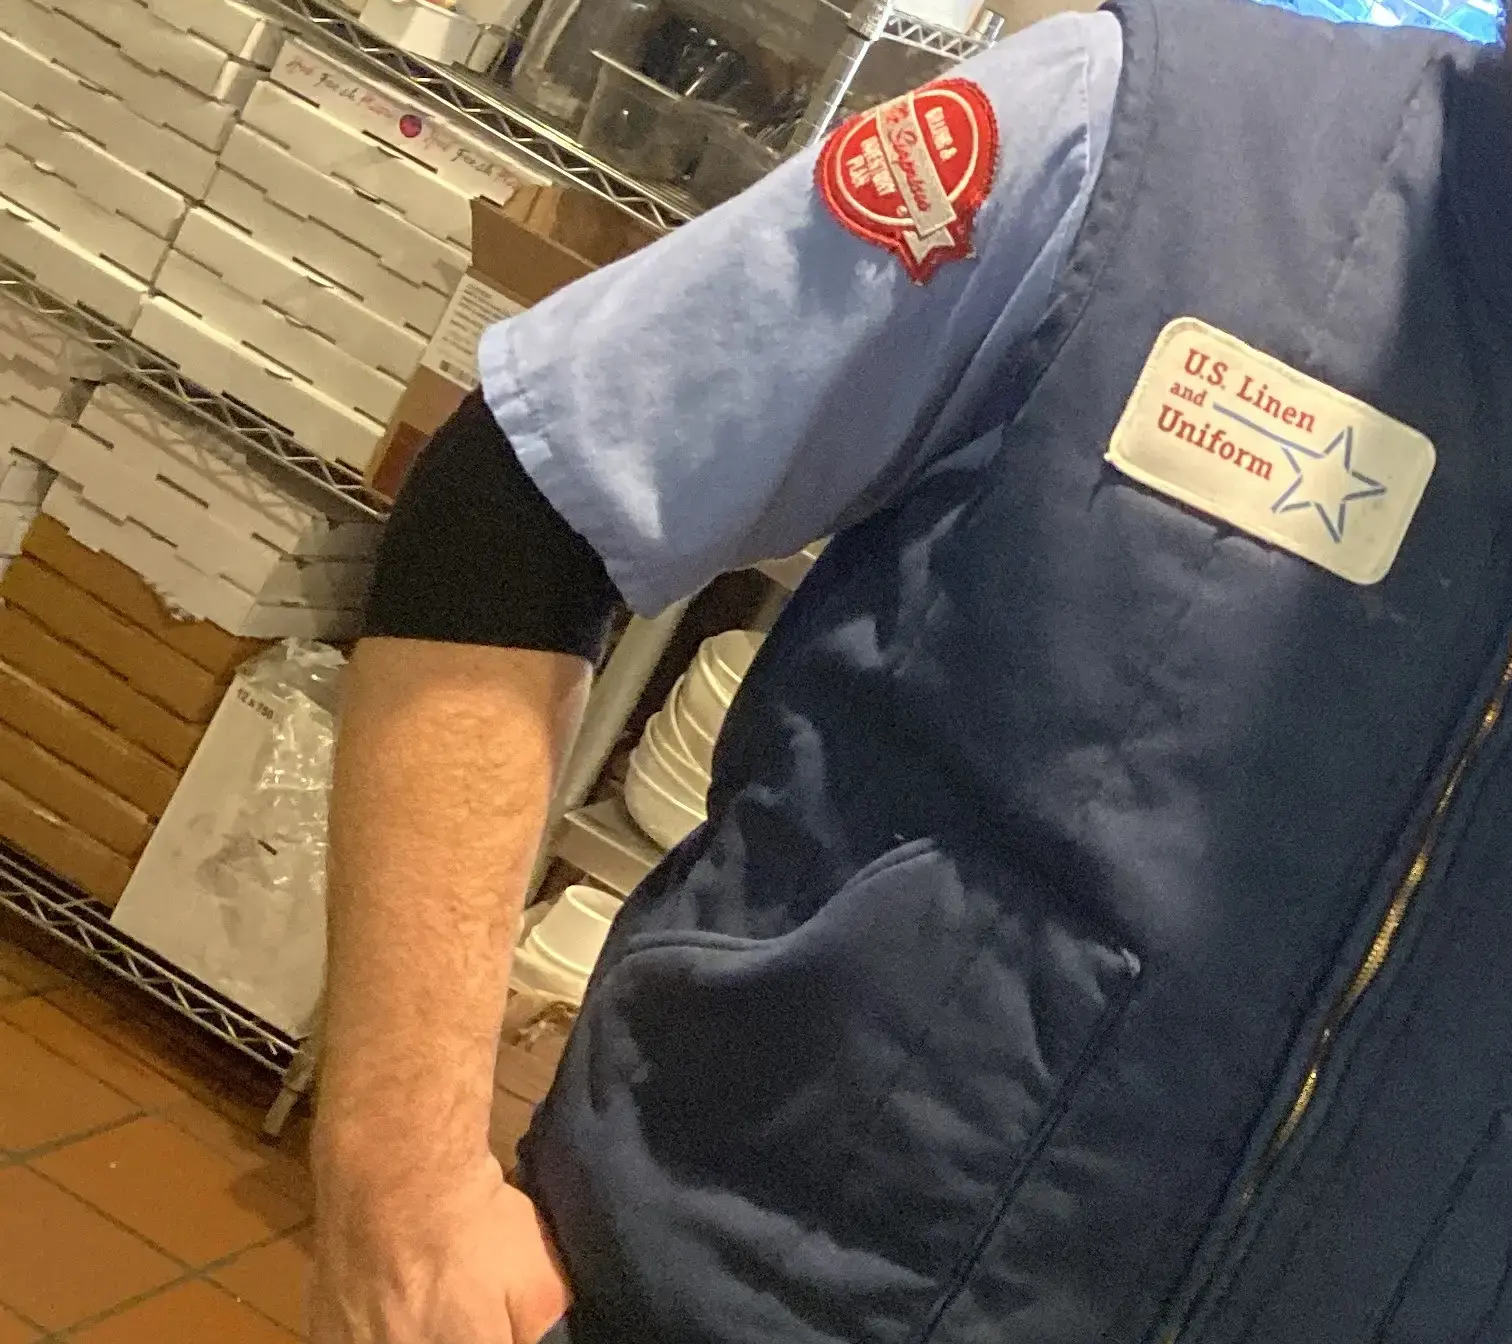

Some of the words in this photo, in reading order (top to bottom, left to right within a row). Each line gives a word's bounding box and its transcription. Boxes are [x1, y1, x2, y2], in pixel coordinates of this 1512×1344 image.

[1169, 381, 1208, 408] and
[1183, 347, 1229, 390] U.S.
[1235, 375, 1316, 434] Linen
[1156, 403, 1274, 481] Uniform
